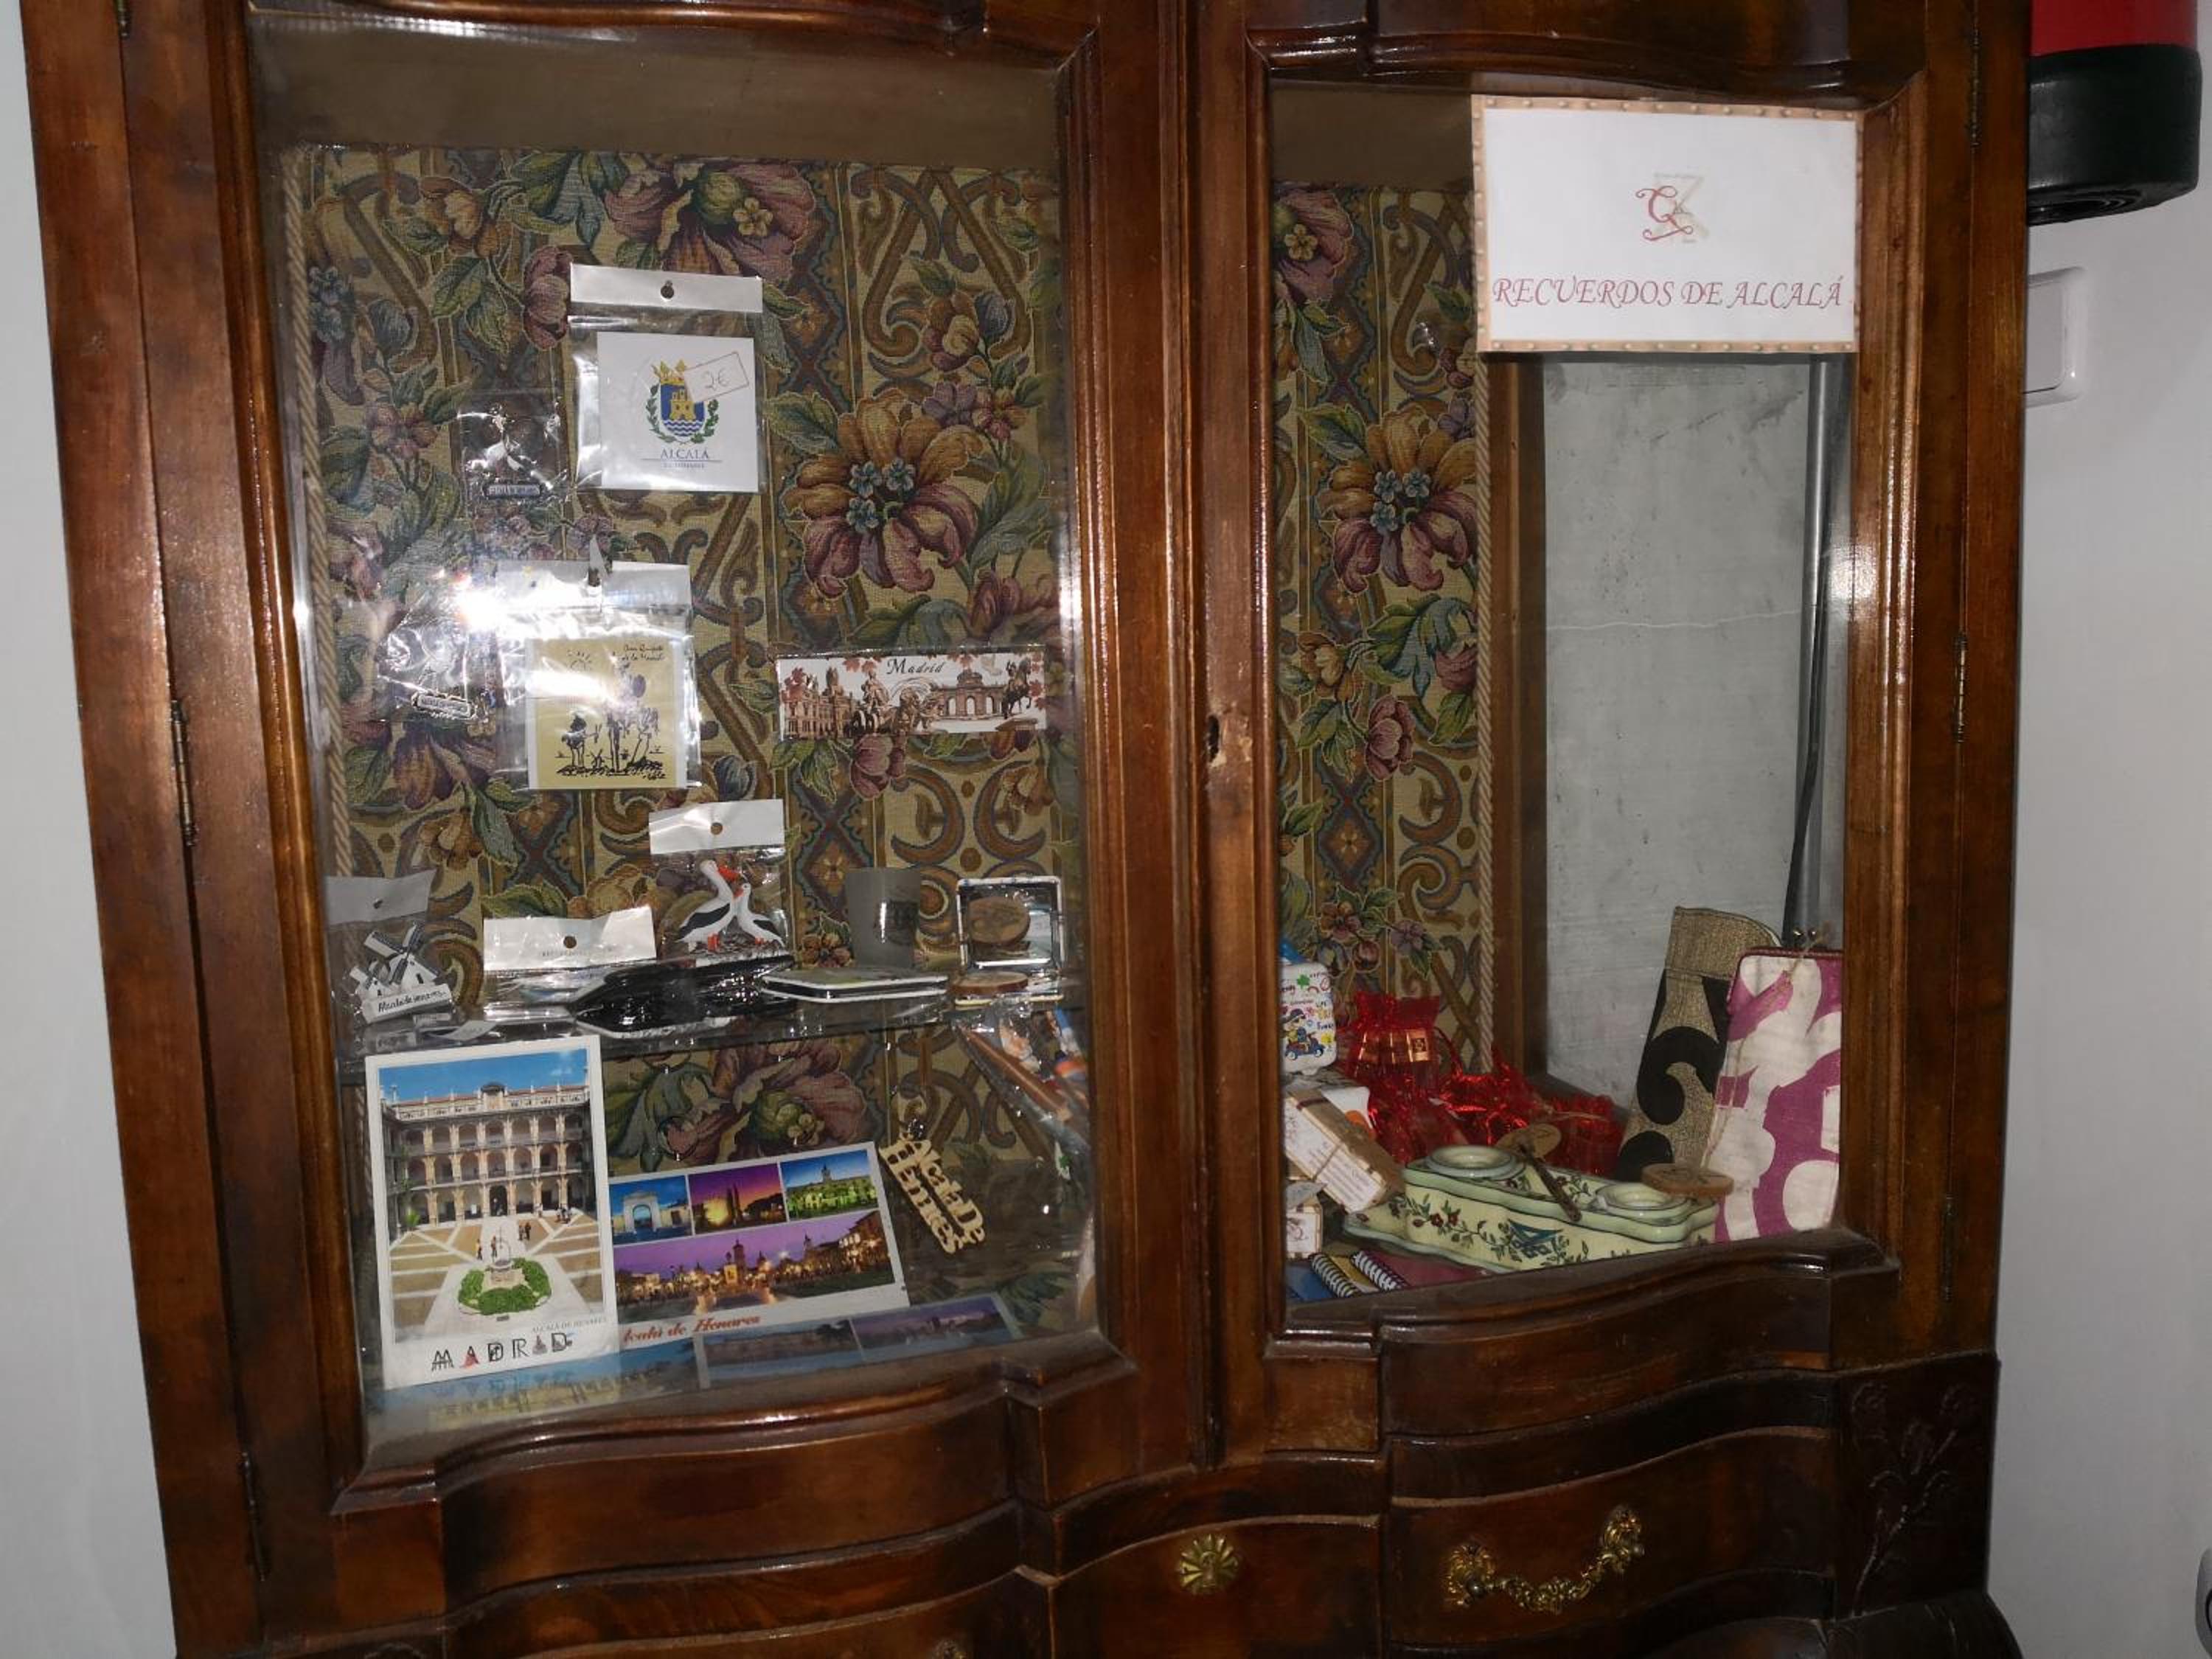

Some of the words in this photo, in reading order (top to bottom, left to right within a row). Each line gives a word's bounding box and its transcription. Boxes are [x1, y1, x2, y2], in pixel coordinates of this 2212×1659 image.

[1492, 274, 1674, 309] RECUERDOS
[1680, 280, 1723, 306] DE
[1725, 274, 1843, 309] ALCALÁ
[886, 658, 946, 675] Madrid
[667, 1322, 686, 1338] de
[694, 1315, 761, 1333] Henares
[431, 1332, 574, 1372] MADRID
